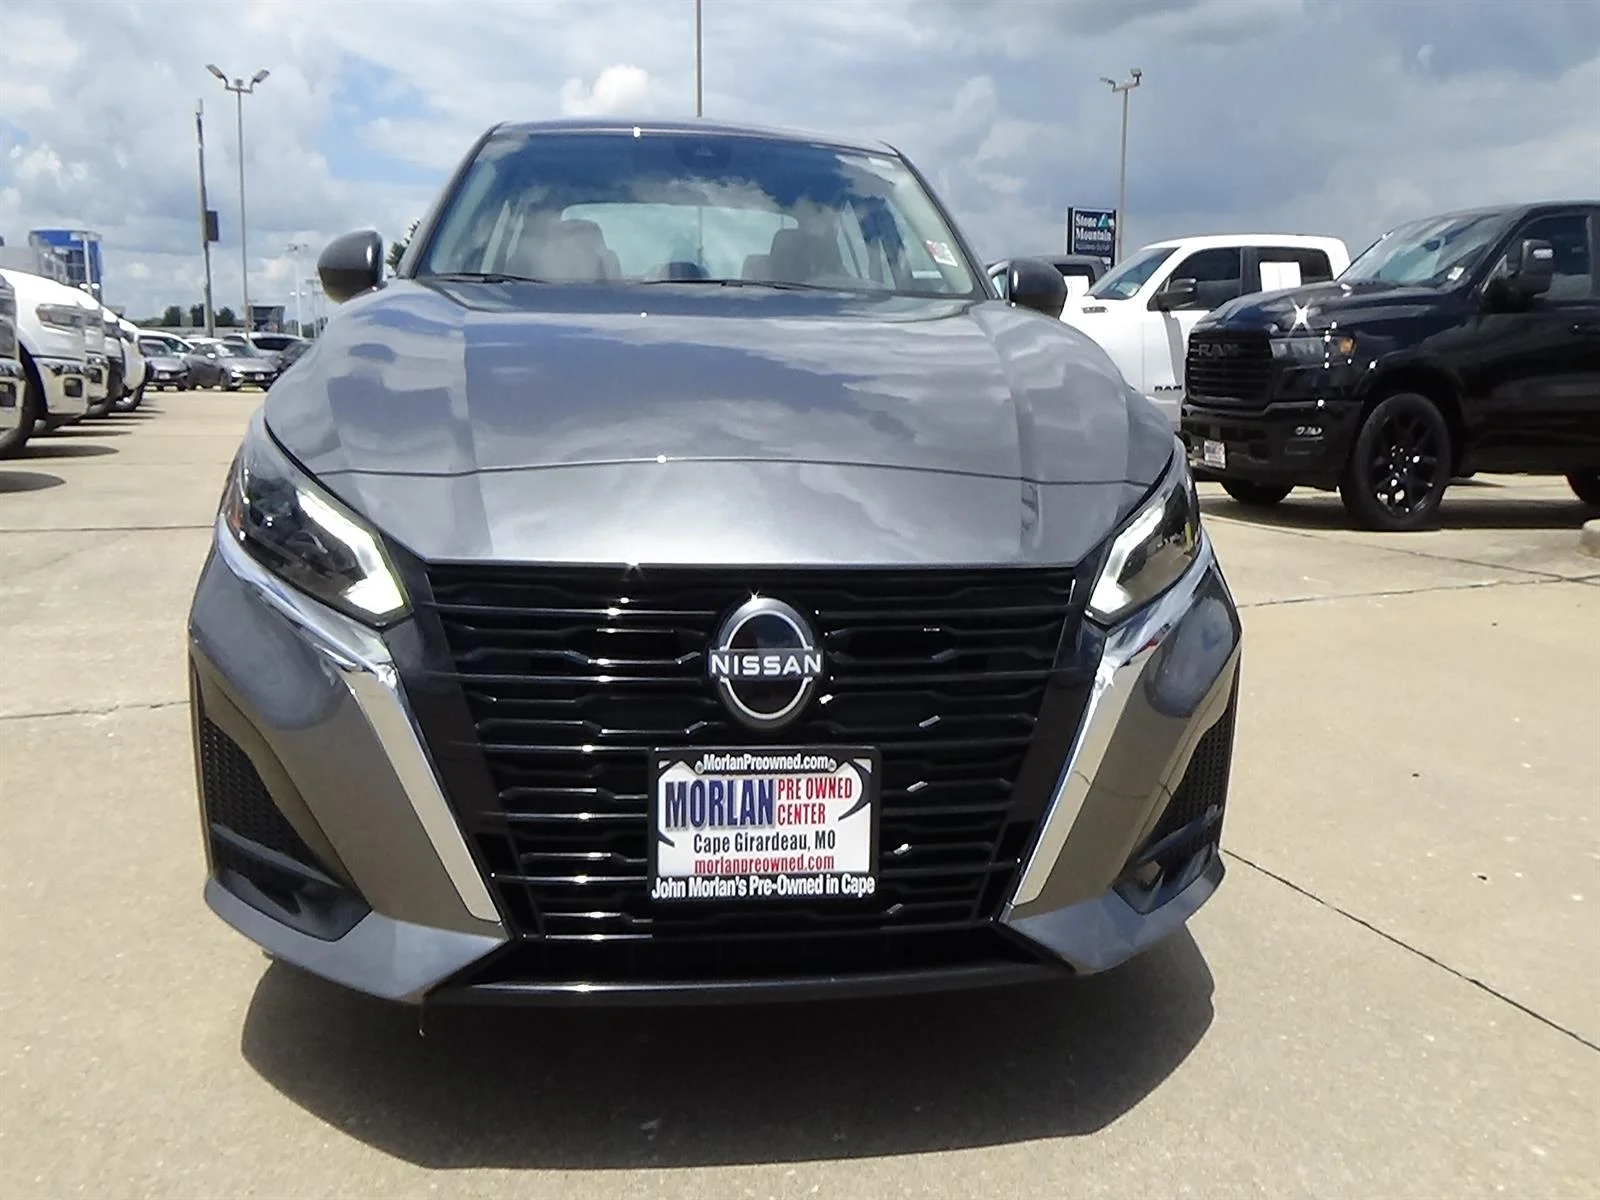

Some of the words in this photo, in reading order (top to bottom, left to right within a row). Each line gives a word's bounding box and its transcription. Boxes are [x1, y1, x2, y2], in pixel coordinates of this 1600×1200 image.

[1075, 212, 1097, 227] Stone
[1075, 227, 1112, 241] Mountain
[710, 654, 823, 676] NISSAN
[703, 753, 829, 771] MorlanPreowned.com
[665, 779, 774, 828] MORLAN
[778, 778, 801, 800] PRE
[806, 777, 853, 799] OWNED
[778, 803, 826, 825] CENTER
[693, 833, 730, 854] Cape
[735, 832, 811, 852] Girardeau,
[814, 830, 836, 849] MO
[694, 854, 835, 874] morlanpreowned.com
[652, 877, 686, 899] John
[688, 876, 748, 897] Morlan's
[749, 875, 824, 896] Pre-Owned
[826, 874, 839, 894] in
[841, 873, 876, 898] Cape
